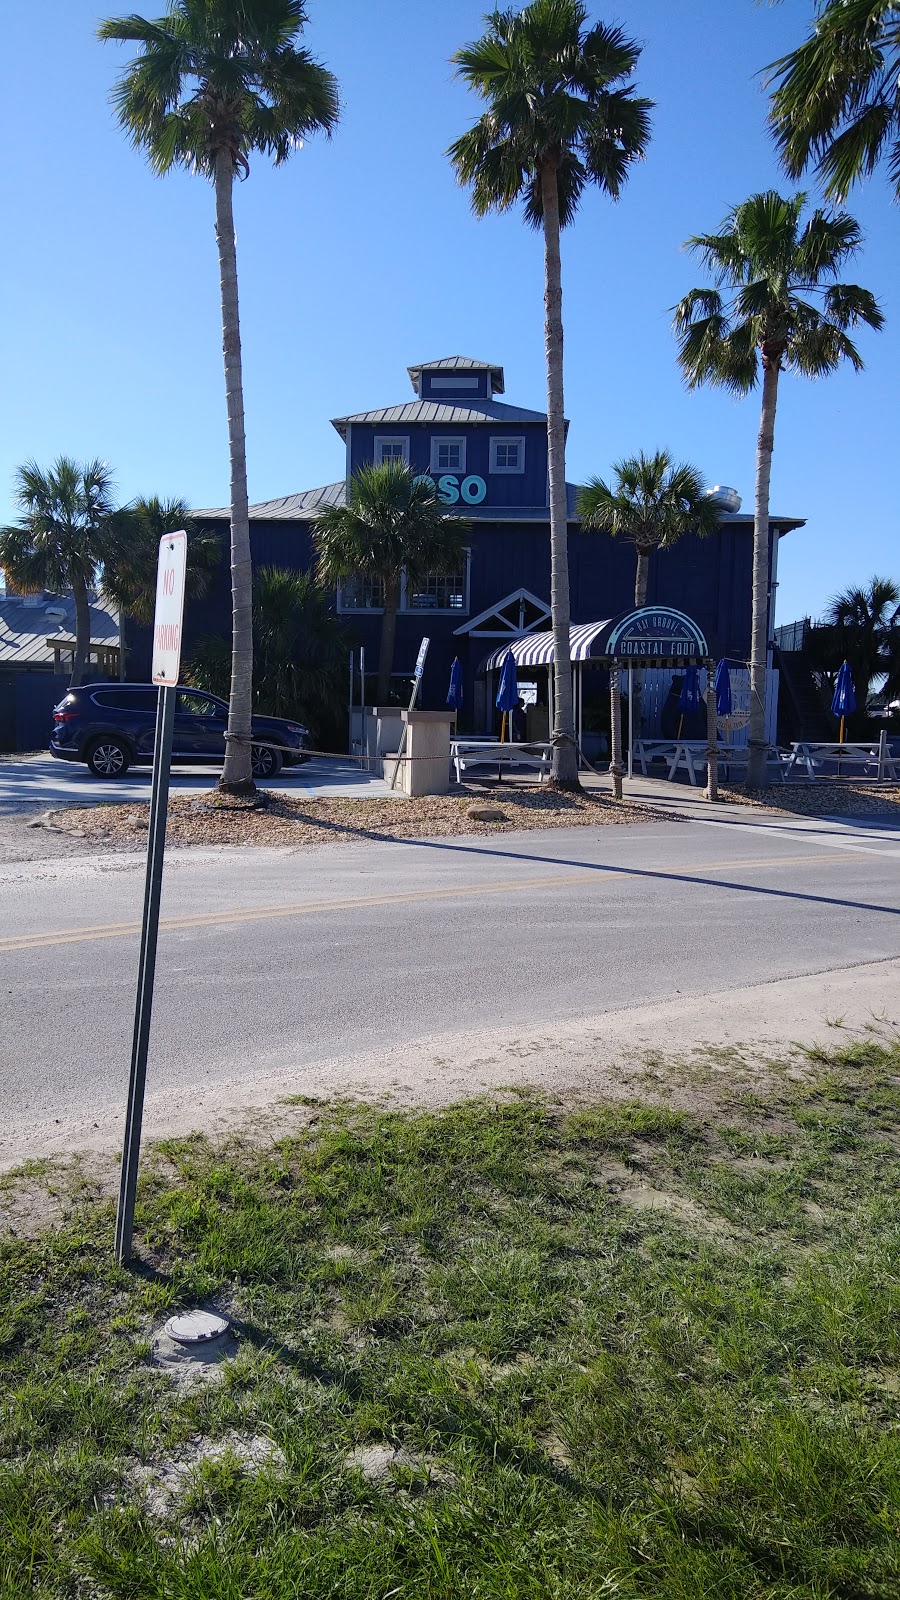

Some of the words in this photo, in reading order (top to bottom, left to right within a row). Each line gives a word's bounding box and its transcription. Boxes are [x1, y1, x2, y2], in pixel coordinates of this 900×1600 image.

[163, 568, 175, 596] NO
[636, 618, 650, 632] BAY
[653, 616, 680, 632] GROOVE
[155, 623, 179, 651] PARKING
[620, 641, 664, 655] COASTAL
[671, 642, 695, 655] FOOD
